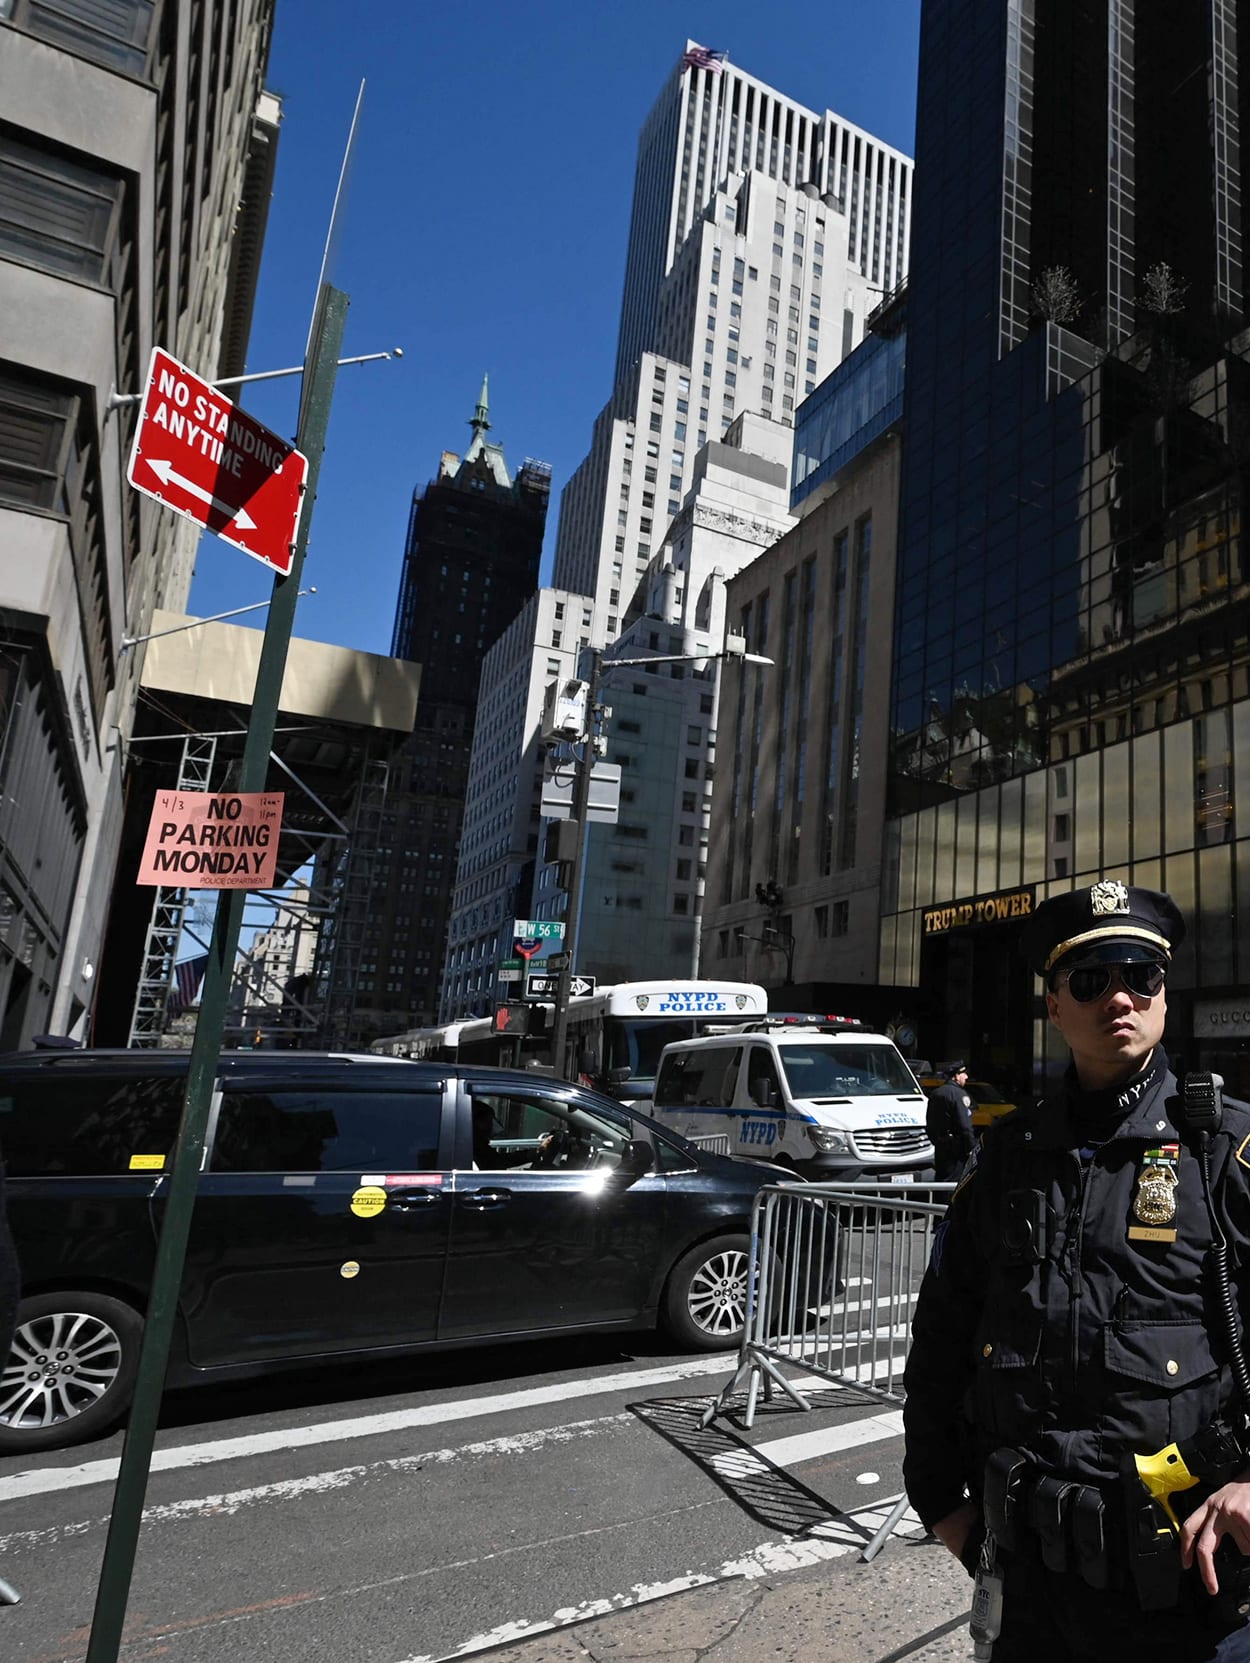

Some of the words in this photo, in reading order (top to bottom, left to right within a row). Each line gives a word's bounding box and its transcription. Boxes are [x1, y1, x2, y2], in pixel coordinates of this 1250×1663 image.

[158, 368, 190, 408] NO
[193, 395, 284, 475] STANDING
[152, 402, 244, 479] ANYTIME
[162, 796, 184, 812] 4/3
[207, 798, 242, 820] NO
[159, 822, 270, 847] PARKING
[153, 849, 267, 874] MONDAY
[200, 877, 226, 885] POLICE
[226, 877, 267, 885] DEPARTMENT
[924, 904, 973, 932] TRUMP
[975, 891, 1032, 922] TOWER
[527, 923, 536, 936] W
[538, 923, 551, 937] 56
[537, 982, 558, 992] ONE
[570, 982, 585, 991] AY
[668, 992, 718, 1002] NYPD
[659, 1003, 726, 1012] POLICE
[875, 1117, 918, 1126] POLICE
[739, 1121, 776, 1145] NYPD
[1144, 1230, 1160, 1239] ZHU
